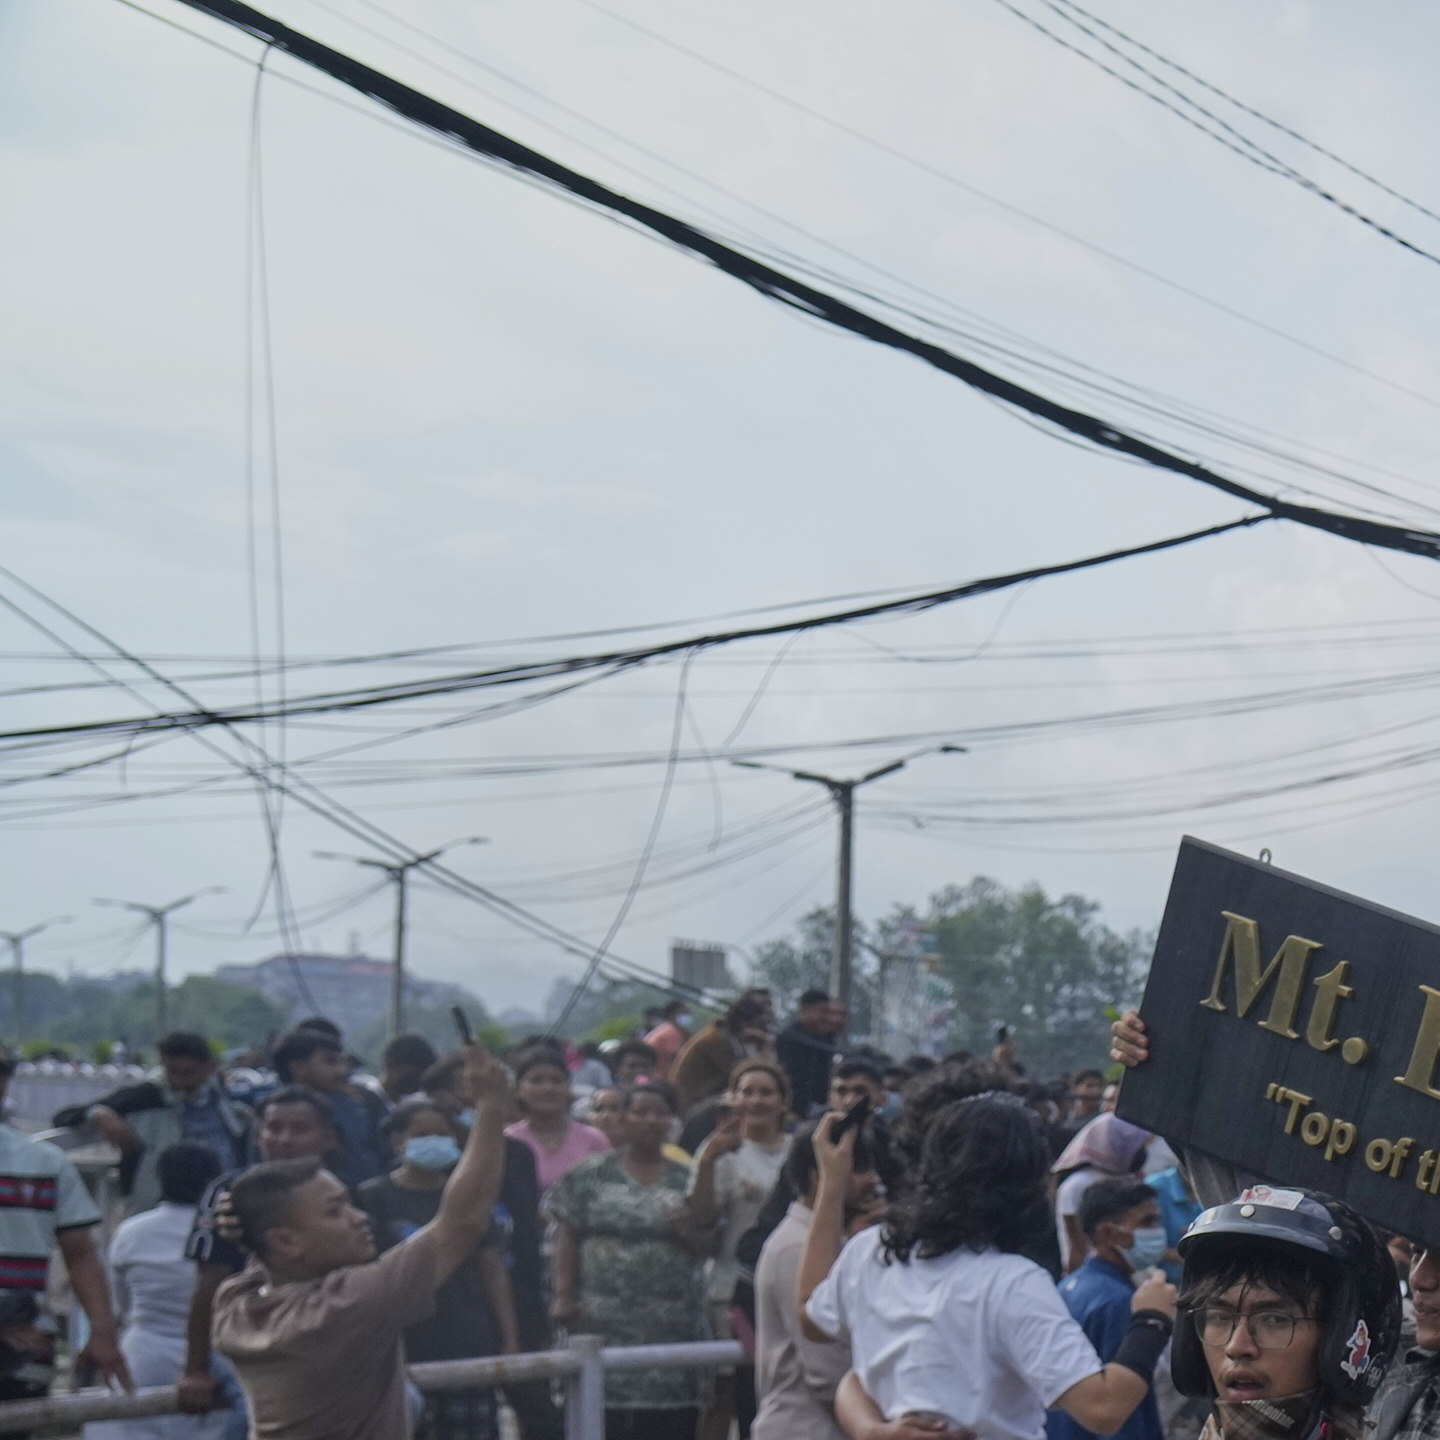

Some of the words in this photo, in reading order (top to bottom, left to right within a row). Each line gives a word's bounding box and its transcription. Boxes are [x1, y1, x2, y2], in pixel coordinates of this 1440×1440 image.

[1199, 911, 1368, 1066] Mt.
[1265, 1082, 1358, 1162] "Top
[1365, 1136, 1416, 1180] of
